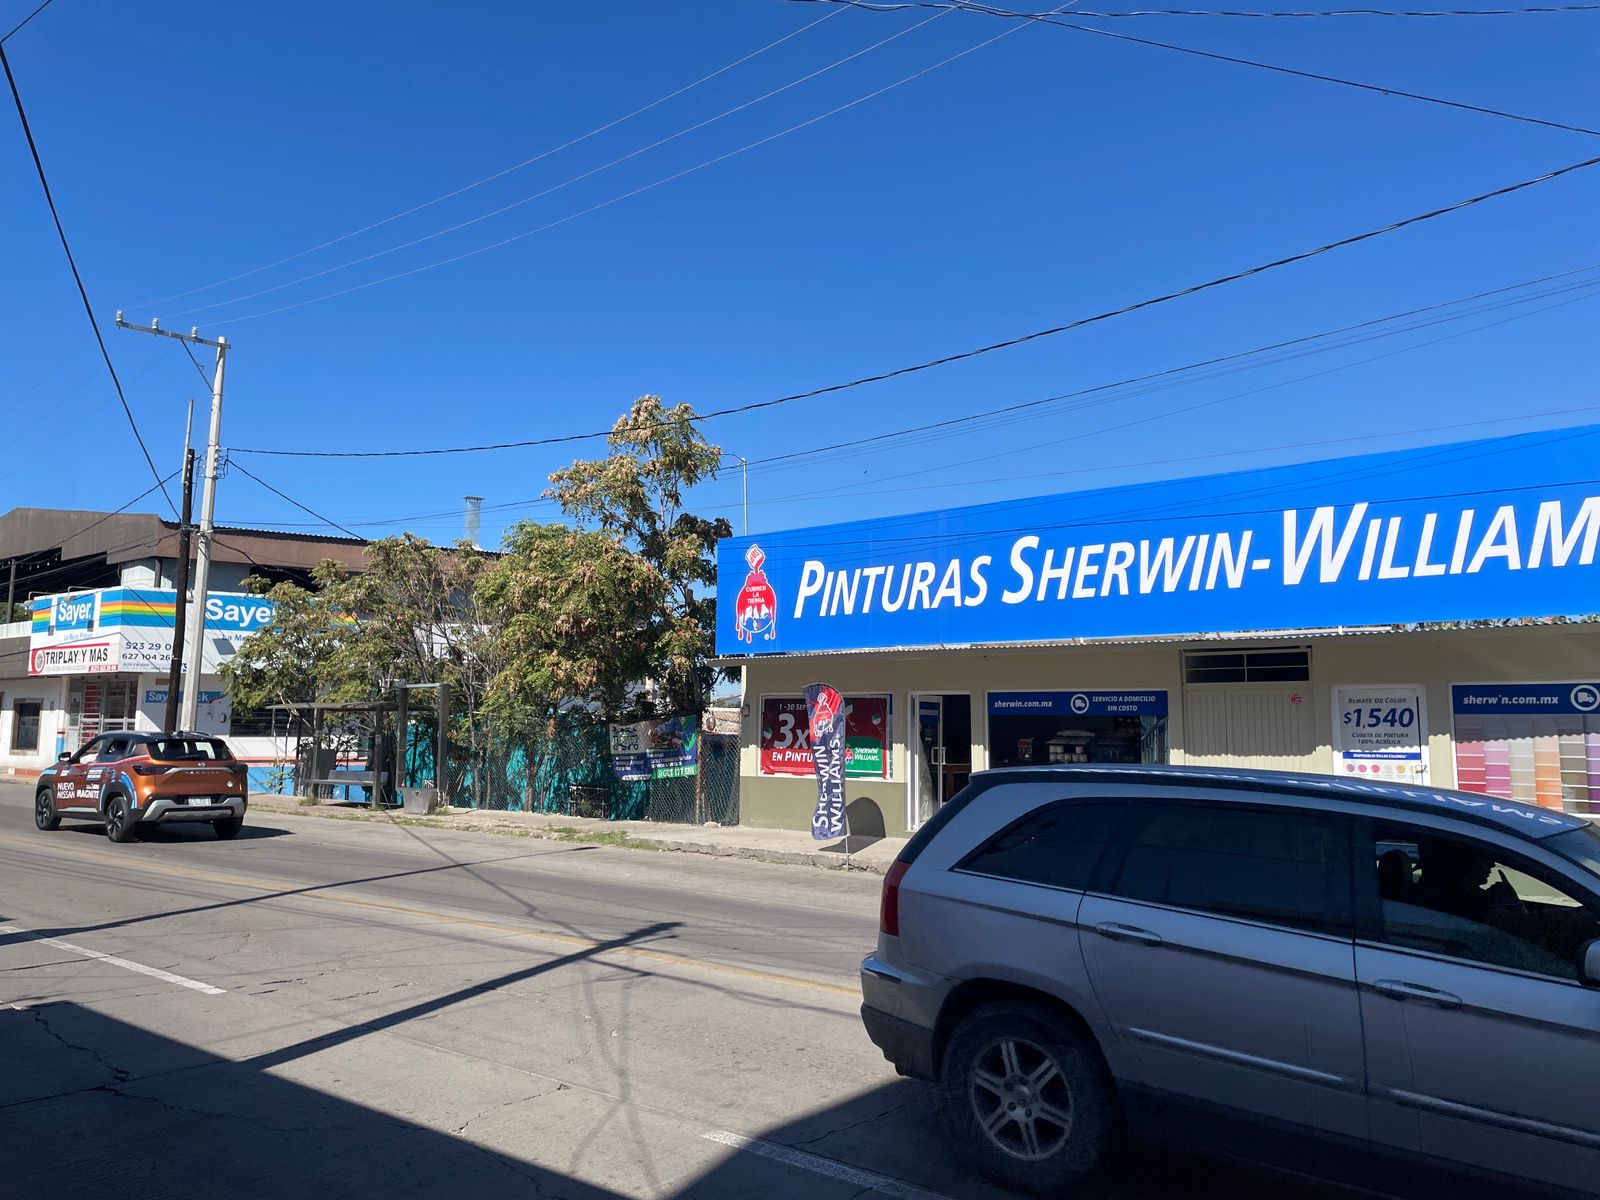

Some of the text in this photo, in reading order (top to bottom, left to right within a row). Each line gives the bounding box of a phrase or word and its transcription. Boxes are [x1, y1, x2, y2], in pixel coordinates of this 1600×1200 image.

[793, 555, 992, 619] PINTURAS
[125, 642, 145, 650] 523
[46, 649, 80, 665] TRIPLAY
[81, 649, 88, 663] Y
[141, 653, 157, 661] 104
[148, 691, 168, 703] Say
[795, 703, 808, 711] SEP
[994, 700, 1053, 708] sherwin.com.mx
[1343, 707, 1414, 729] $1,540
[772, 750, 813, 763] EN PINTU
[57, 782, 75, 791] NUEVO
[56, 789, 100, 799] NISSAN MAGNITE
